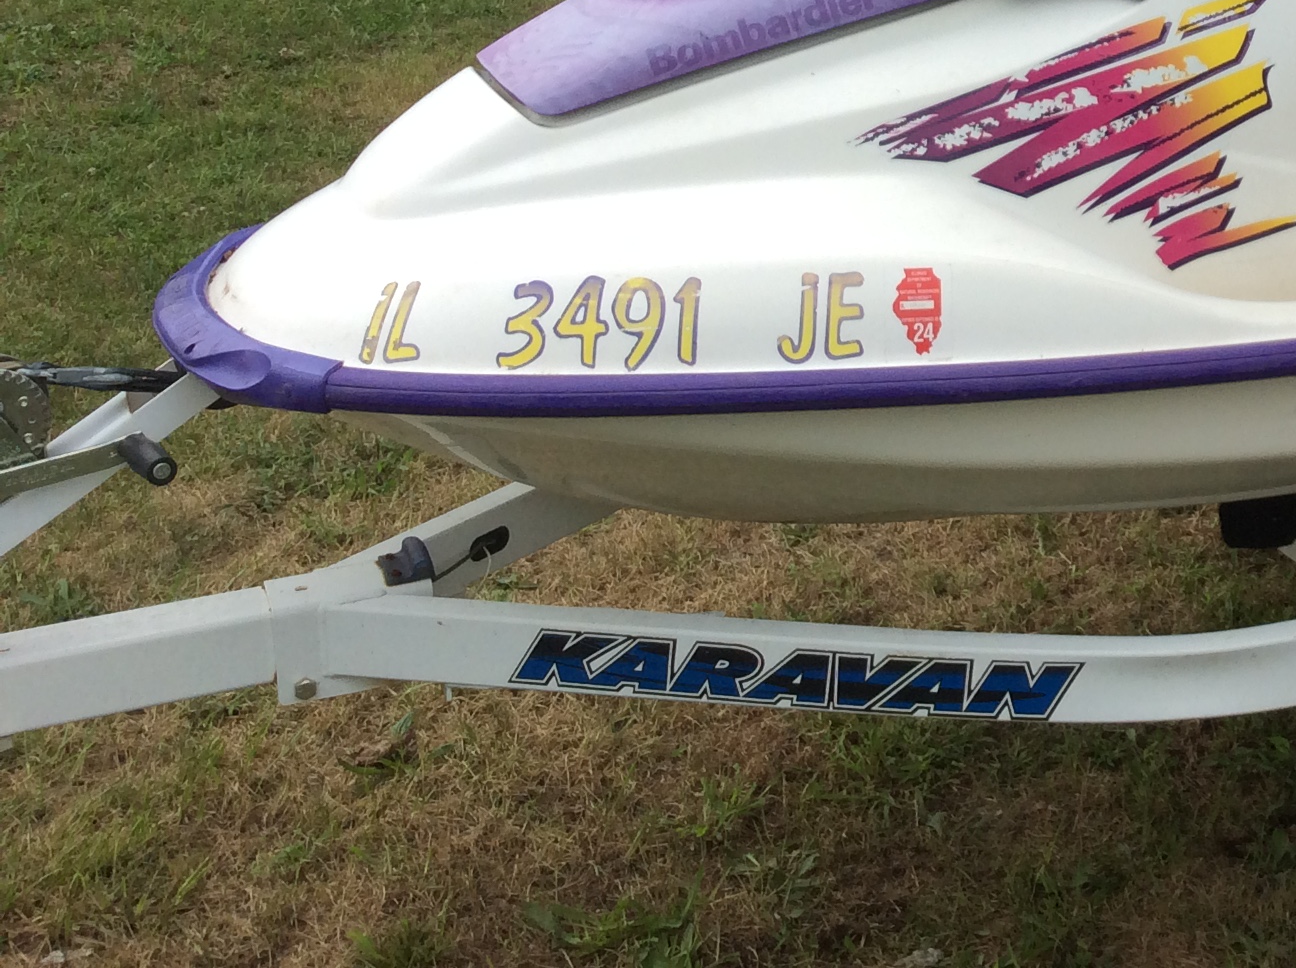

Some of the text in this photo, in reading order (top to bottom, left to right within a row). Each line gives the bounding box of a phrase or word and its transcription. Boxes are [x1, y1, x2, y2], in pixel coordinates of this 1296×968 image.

[358, 271, 865, 371] IL 3491 JE
[913, 322, 935, 343] 24
[508, 628, 1086, 721] KARAVAN
